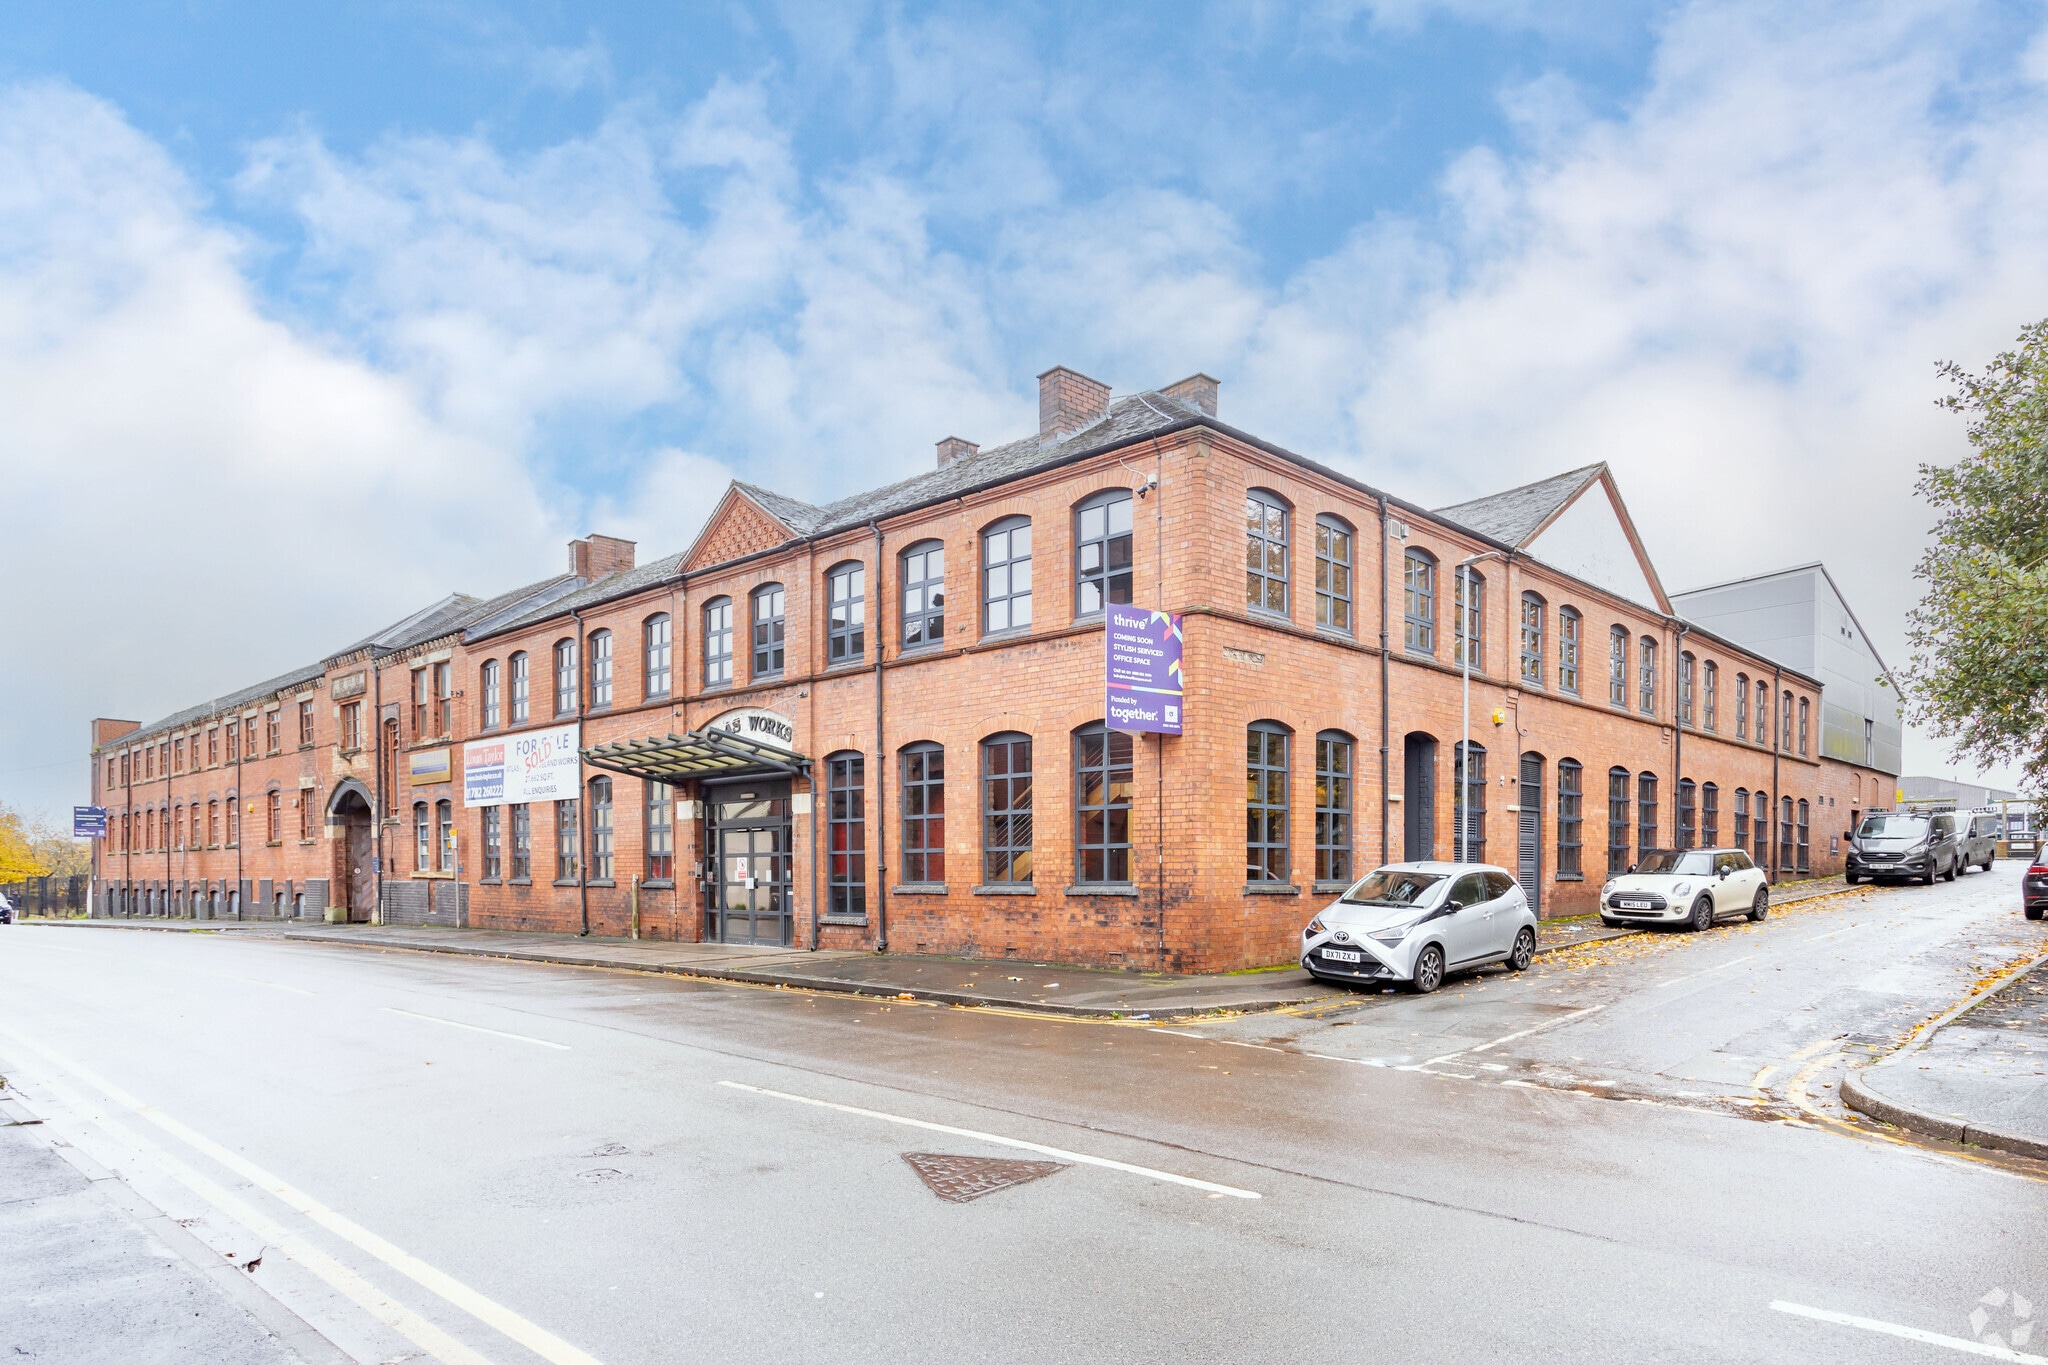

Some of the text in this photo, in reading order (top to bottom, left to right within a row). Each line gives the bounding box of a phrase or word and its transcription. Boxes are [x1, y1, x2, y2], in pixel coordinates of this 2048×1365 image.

[1113, 613, 1146, 630] thrive
[1113, 632, 1154, 645] COMING SOON
[1113, 643, 1164, 657] STYLISH SERVICED
[1113, 654, 1151, 666] OFFICE SPACE
[1110, 695, 1138, 706] Funded by
[748, 716, 793, 743] WORKS
[516, 738, 537, 756] FOR
[466, 747, 504, 767] Louis Taylor
[524, 741, 552, 774] SOLD
[558, 756, 578, 766] WORKS
[532, 784, 557, 795] ENQUIRIES
[1326, 950, 1356, 961] DX71 ZXJ
